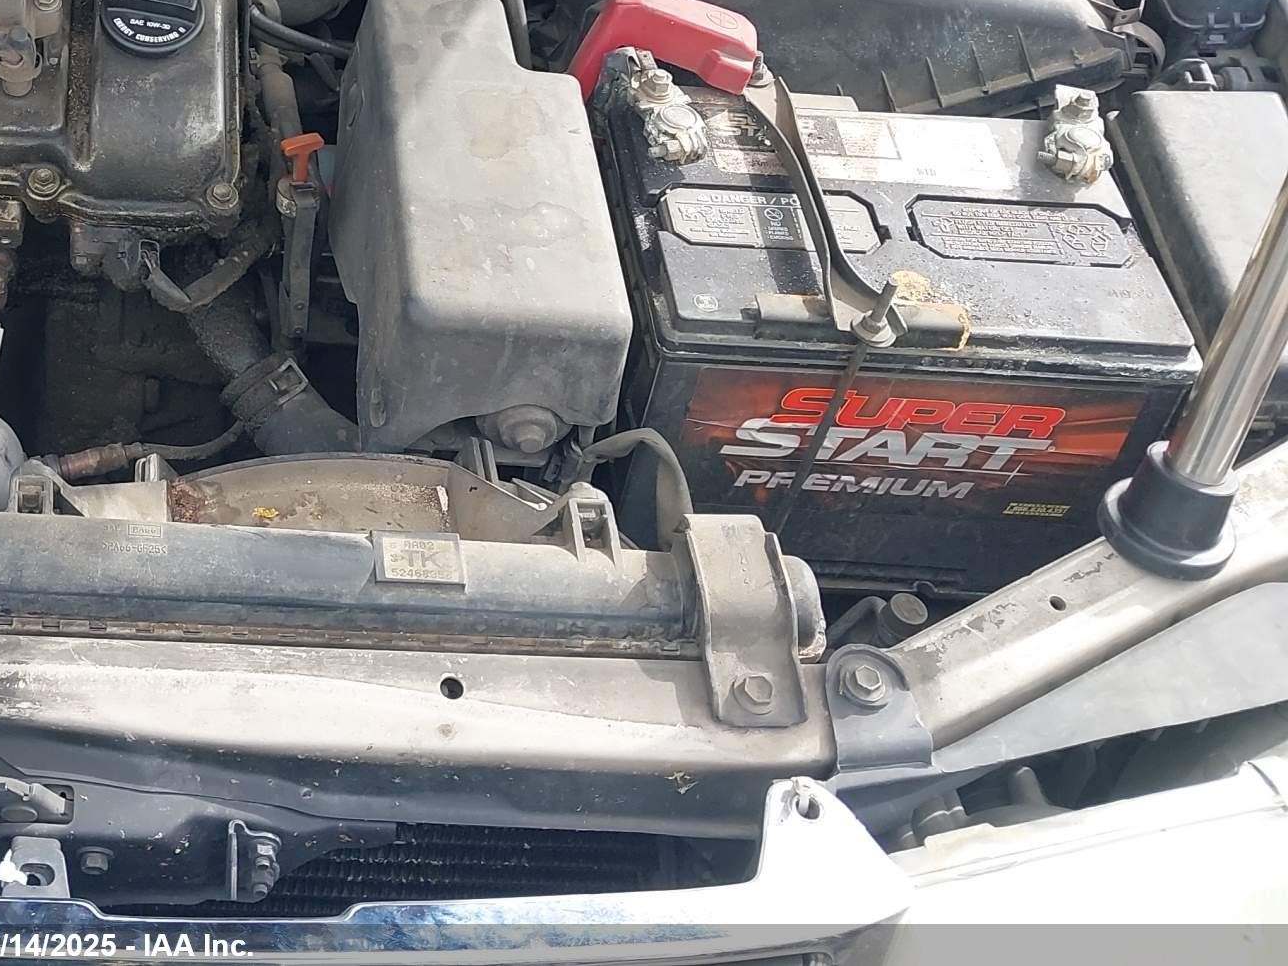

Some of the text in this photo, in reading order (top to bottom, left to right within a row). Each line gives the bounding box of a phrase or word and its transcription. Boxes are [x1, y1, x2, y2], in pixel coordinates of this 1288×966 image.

[113, 17, 135, 37] ENERGY
[135, 31, 180, 43] CONSERVING
[129, 18, 145, 26] SAE
[712, 194, 768, 205] DANGER
[769, 388, 1066, 439] SUPER
[719, 418, 1053, 470] START
[733, 470, 975, 499] PREMIUM
